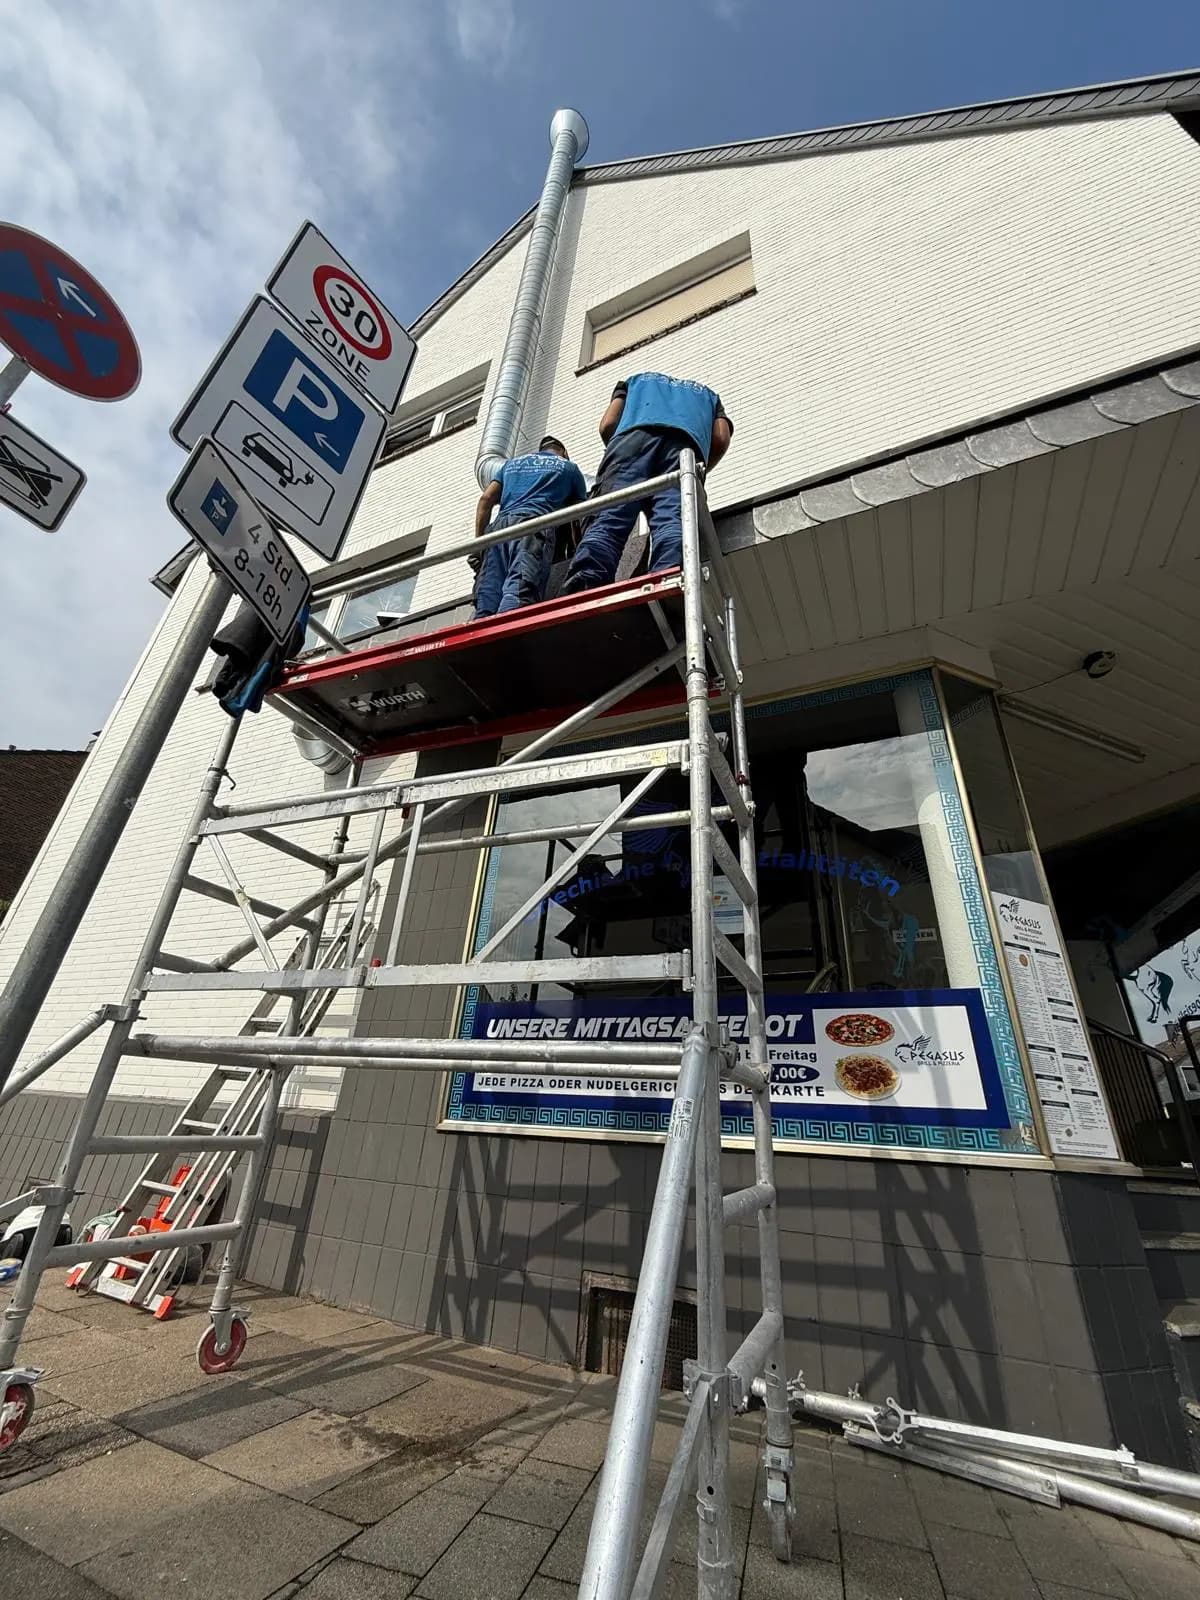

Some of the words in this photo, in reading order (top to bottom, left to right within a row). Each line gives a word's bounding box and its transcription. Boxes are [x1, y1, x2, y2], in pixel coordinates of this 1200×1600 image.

[329, 283, 377, 343] 30
[304, 309, 371, 383] ZONE
[272, 356, 339, 421] P
[248, 524, 262, 545] 4
[262, 541, 293, 592] Std.
[234, 548, 283, 620] 8-18h
[1009, 913, 1041, 929] PEGASUS
[486, 1018, 571, 1038] UNSERE
[573, 1014, 803, 1038] MITTAGSAEOT
[769, 1050, 817, 1063] Freitag
[910, 1051, 966, 1061] PEGASUS
[772, 1067, 808, 1080] ,00€
[478, 1076, 506, 1087] JEDE
[510, 1077, 544, 1088] PIZZA
[549, 1079, 582, 1090] ODER
[586, 1082, 677, 1093] NUDELGERIC
[770, 1085, 825, 1097] KARTE
